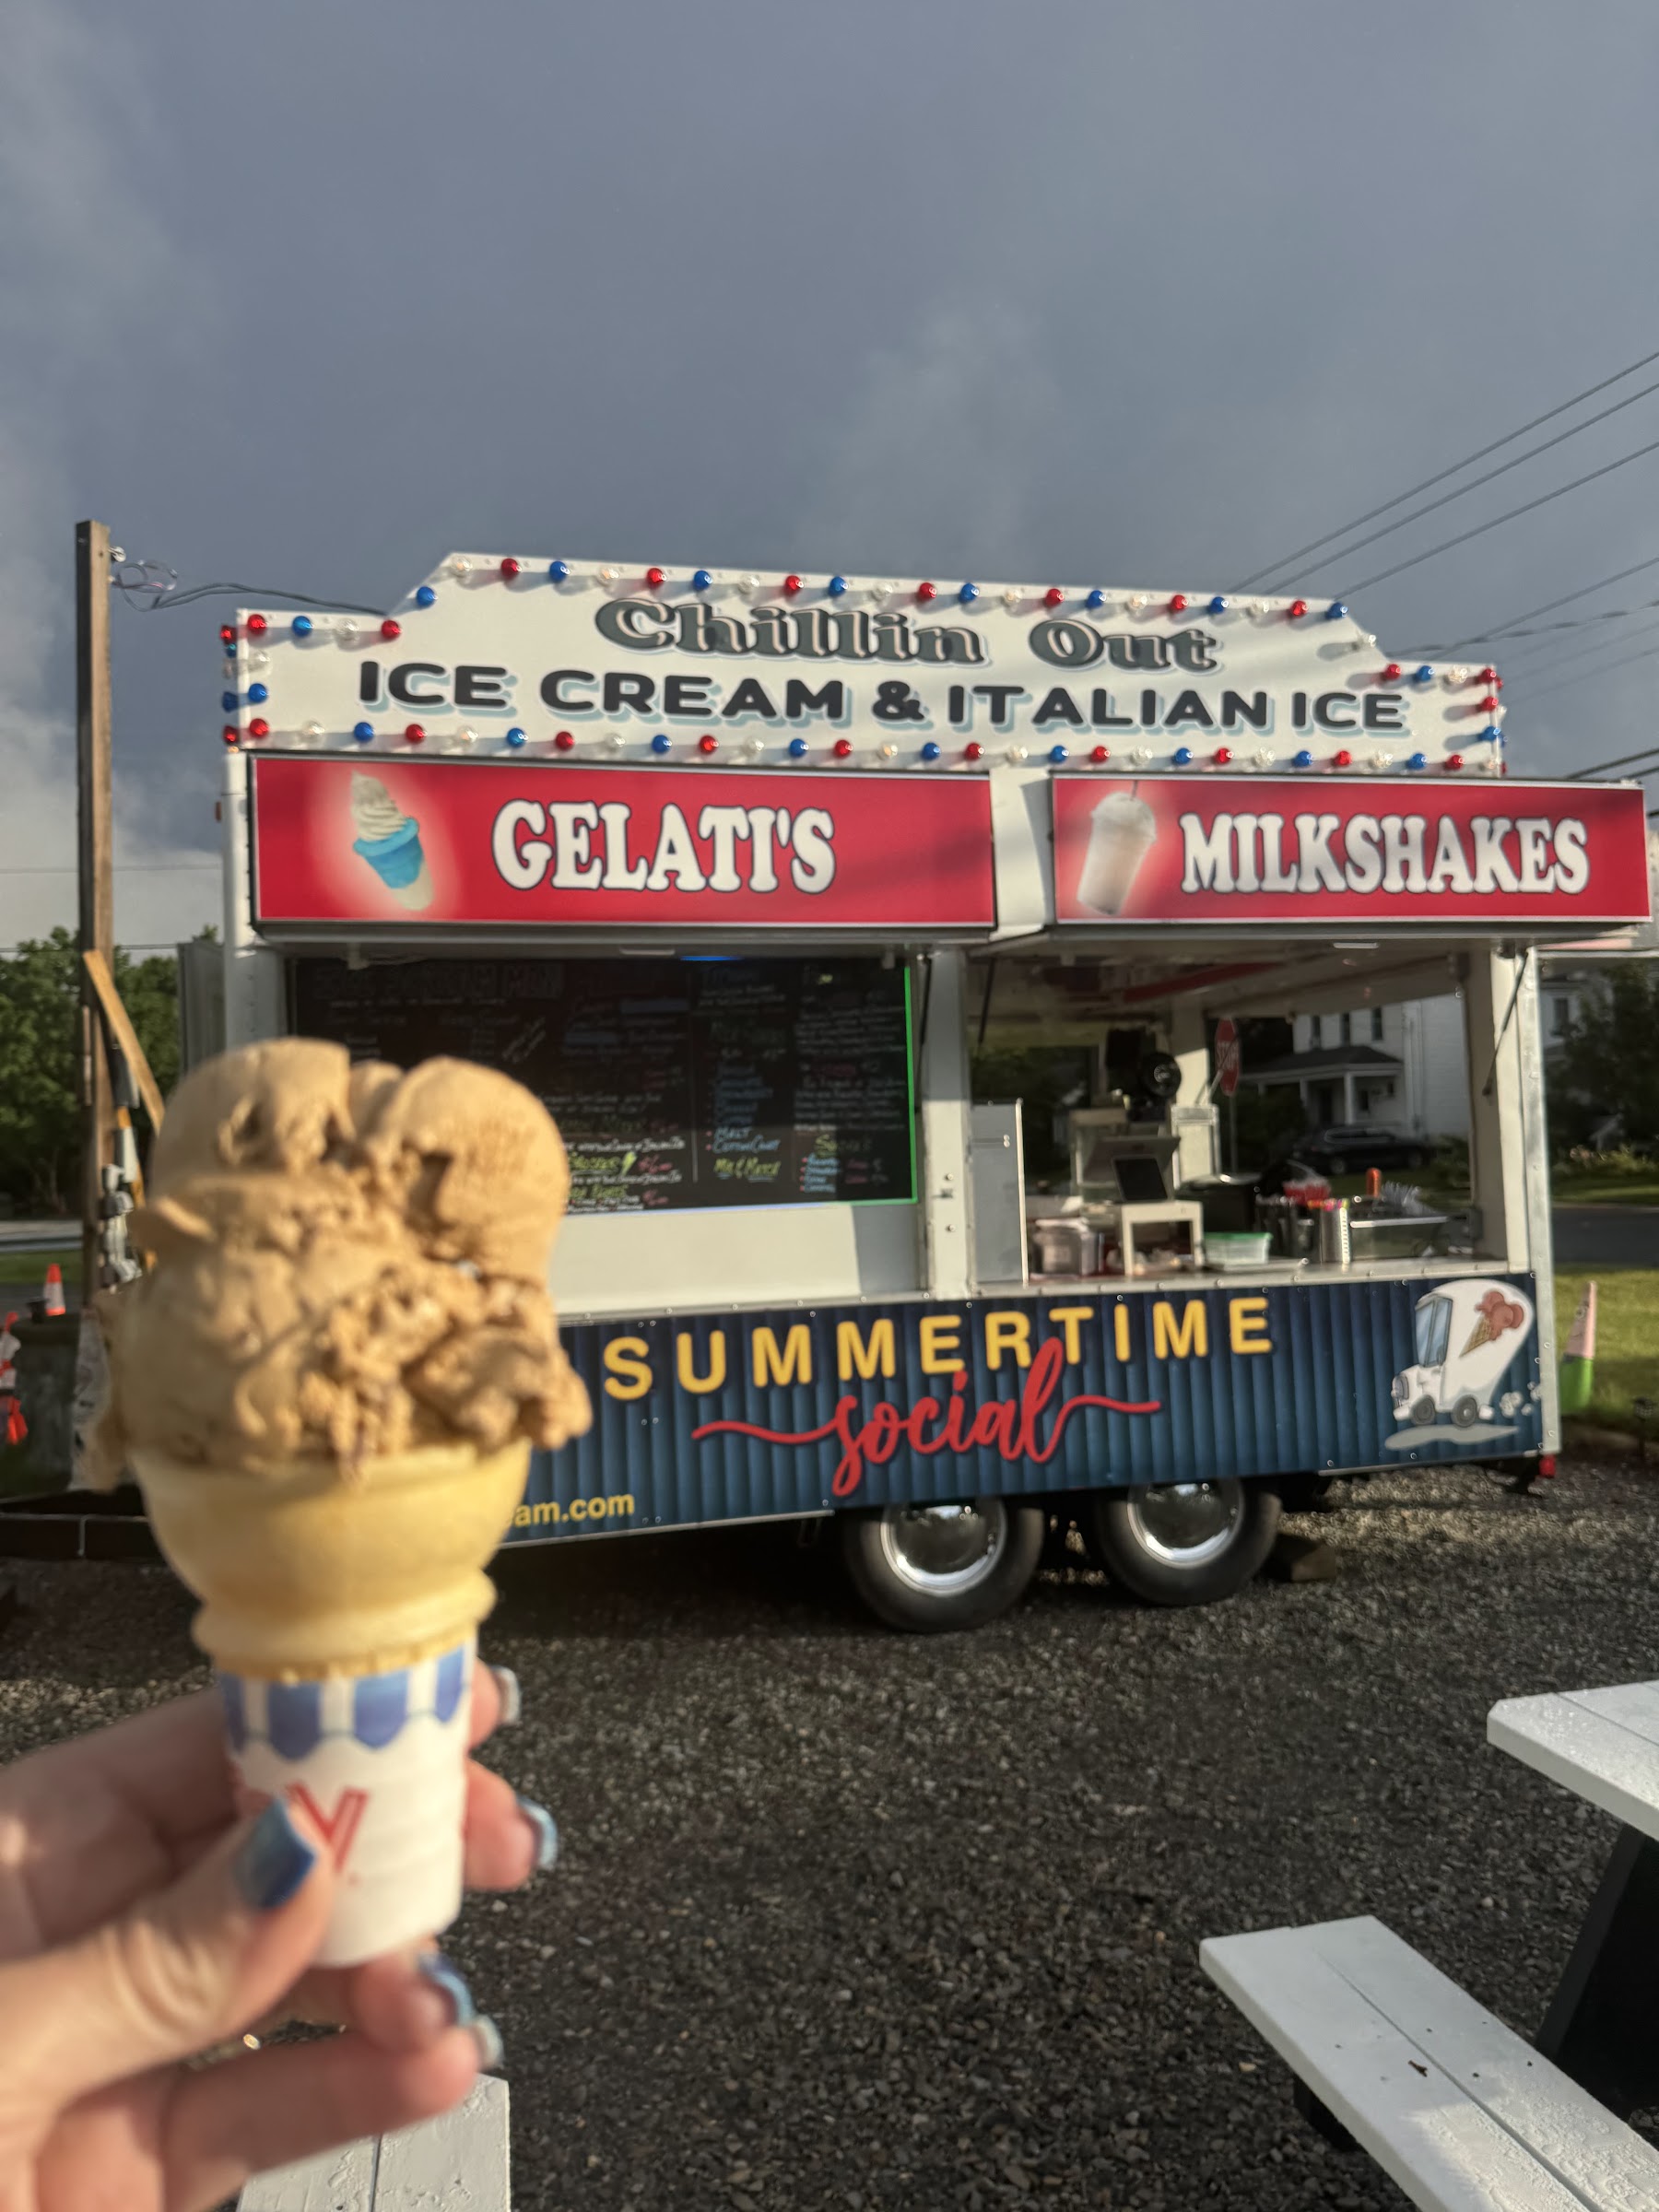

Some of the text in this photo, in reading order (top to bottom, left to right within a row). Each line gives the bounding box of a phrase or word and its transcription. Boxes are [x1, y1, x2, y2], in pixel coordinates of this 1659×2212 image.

[594, 598, 1218, 673] Chillin Out
[359, 660, 1405, 730] ICE CREAM & ITALIAN ICE
[491, 799, 837, 894] GELATI'S
[1179, 813, 1589, 896] MILKSHAKES
[1217, 1041, 1240, 1070] STOP
[603, 1298, 1273, 1399] SUMMERTIME
[693, 1337, 1161, 1497] social
[513, 1493, 636, 1528] am.com
